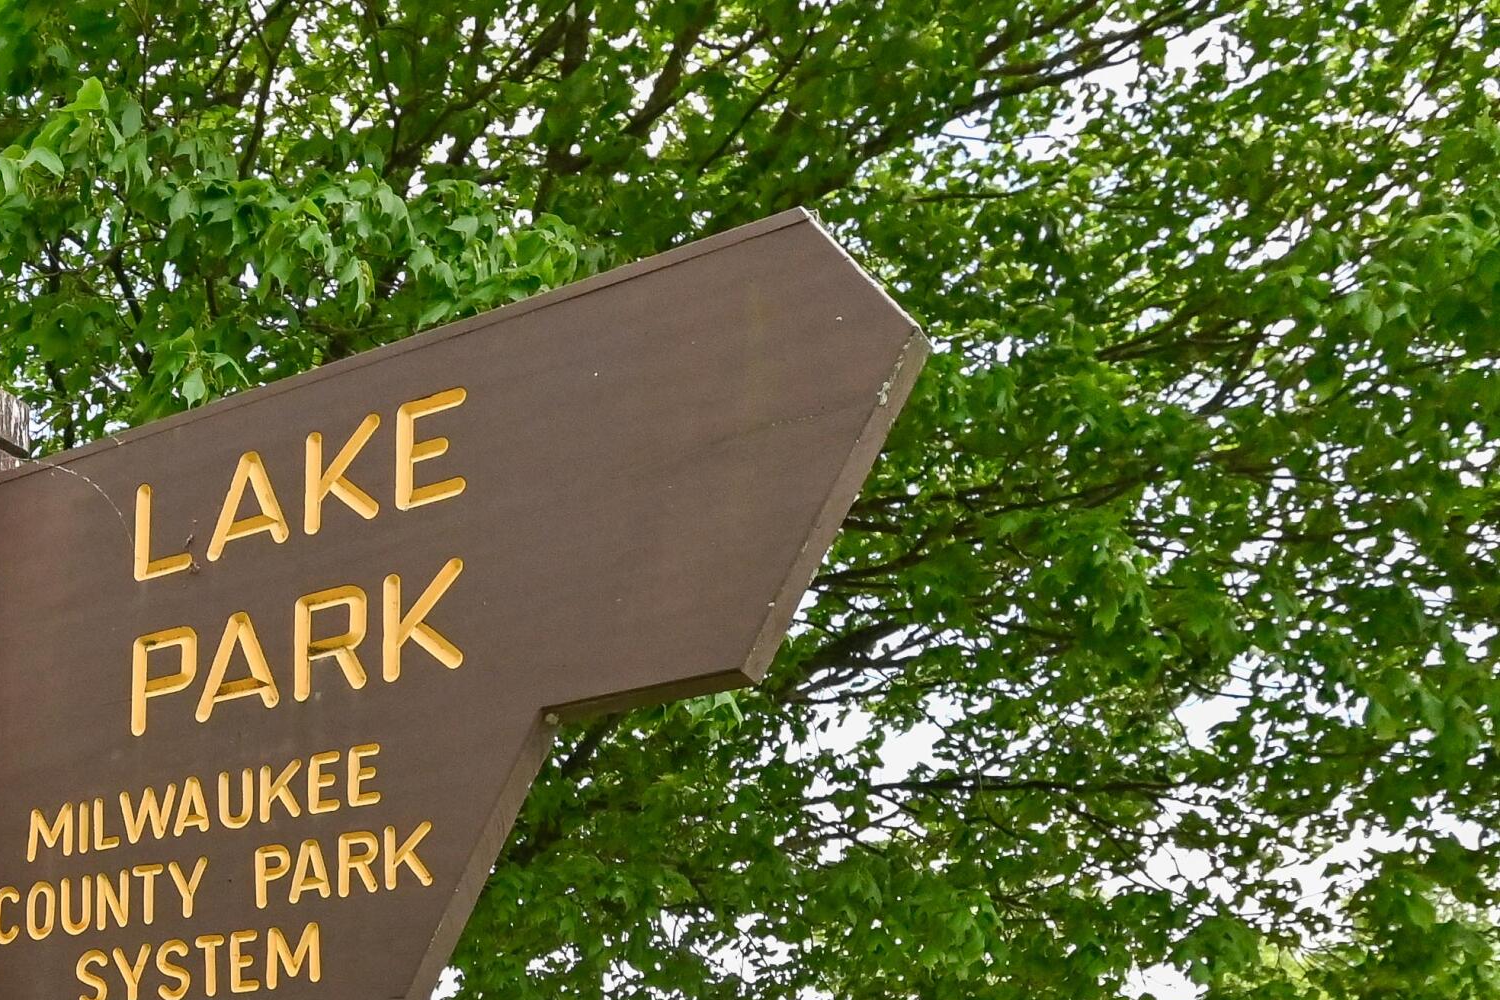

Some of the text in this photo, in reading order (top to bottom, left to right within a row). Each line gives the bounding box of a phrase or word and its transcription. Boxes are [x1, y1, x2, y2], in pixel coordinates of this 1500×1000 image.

[133, 386, 468, 582] LAKE
[131, 556, 465, 737] PARK
[25, 743, 382, 863] MILWAUKEE
[254, 821, 434, 909] PARK
